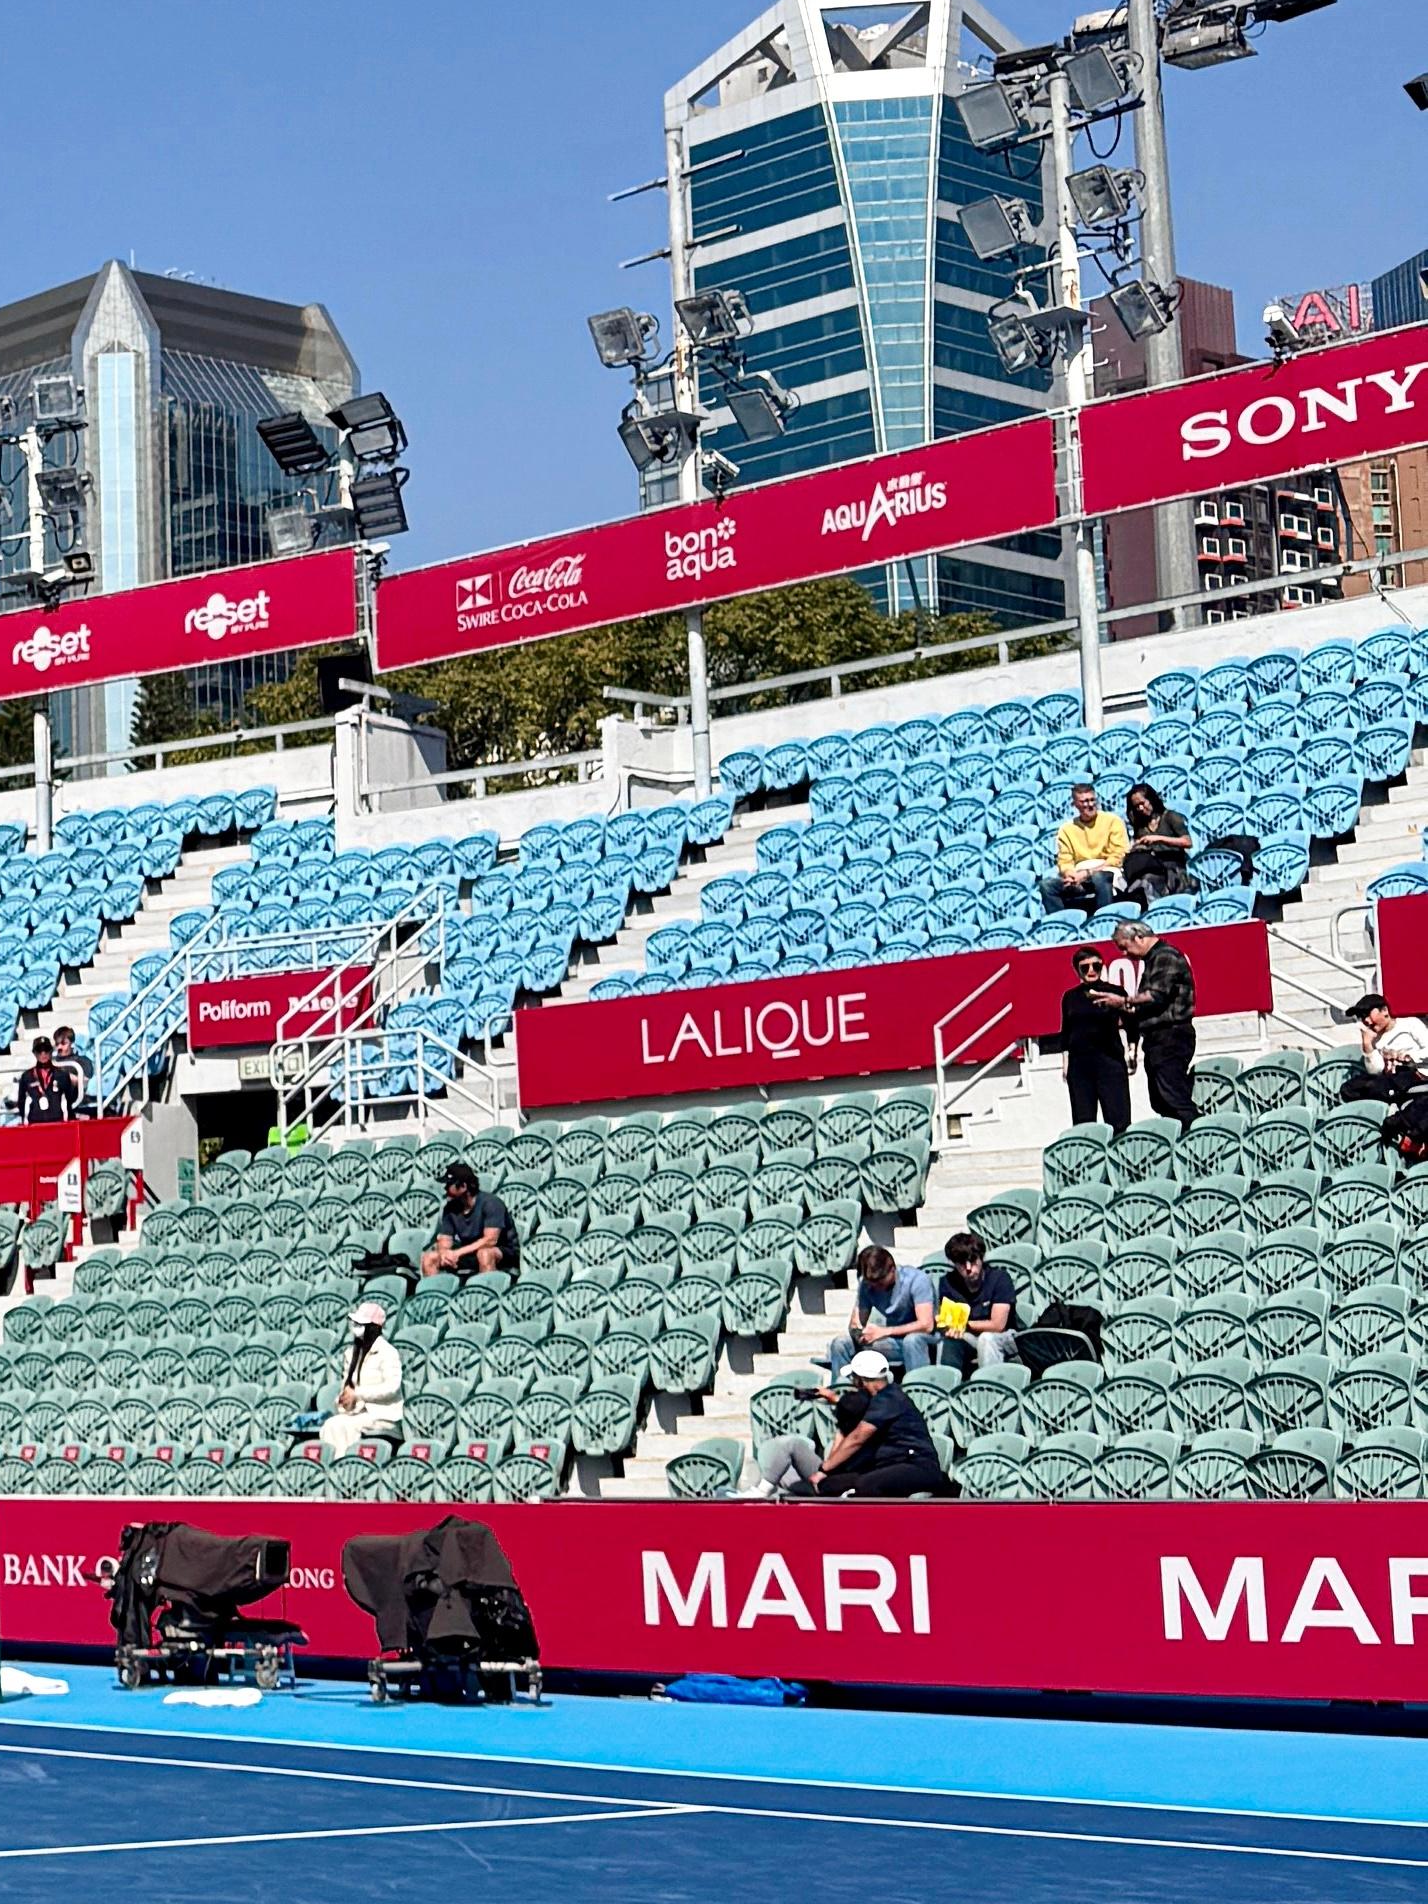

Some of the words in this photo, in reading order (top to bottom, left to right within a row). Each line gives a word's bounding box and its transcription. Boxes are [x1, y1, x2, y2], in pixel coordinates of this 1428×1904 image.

[1293, 283, 1373, 332] AI
[1180, 361, 1428, 461] SONY
[821, 482, 947, 542] AQUARIUS
[664, 531, 718, 557] bon
[666, 546, 737, 581] aqua
[508, 553, 587, 598] Coca-Cola
[457, 610, 499, 632] SWIRE
[199, 999, 271, 1022] Poliform
[641, 992, 871, 1065] LALIQUE
[3, 1554, 87, 1587] BANK
[285, 1567, 335, 1590] ONG
[641, 1551, 932, 1635] MARI
[1160, 1556, 1428, 1646] MAR
